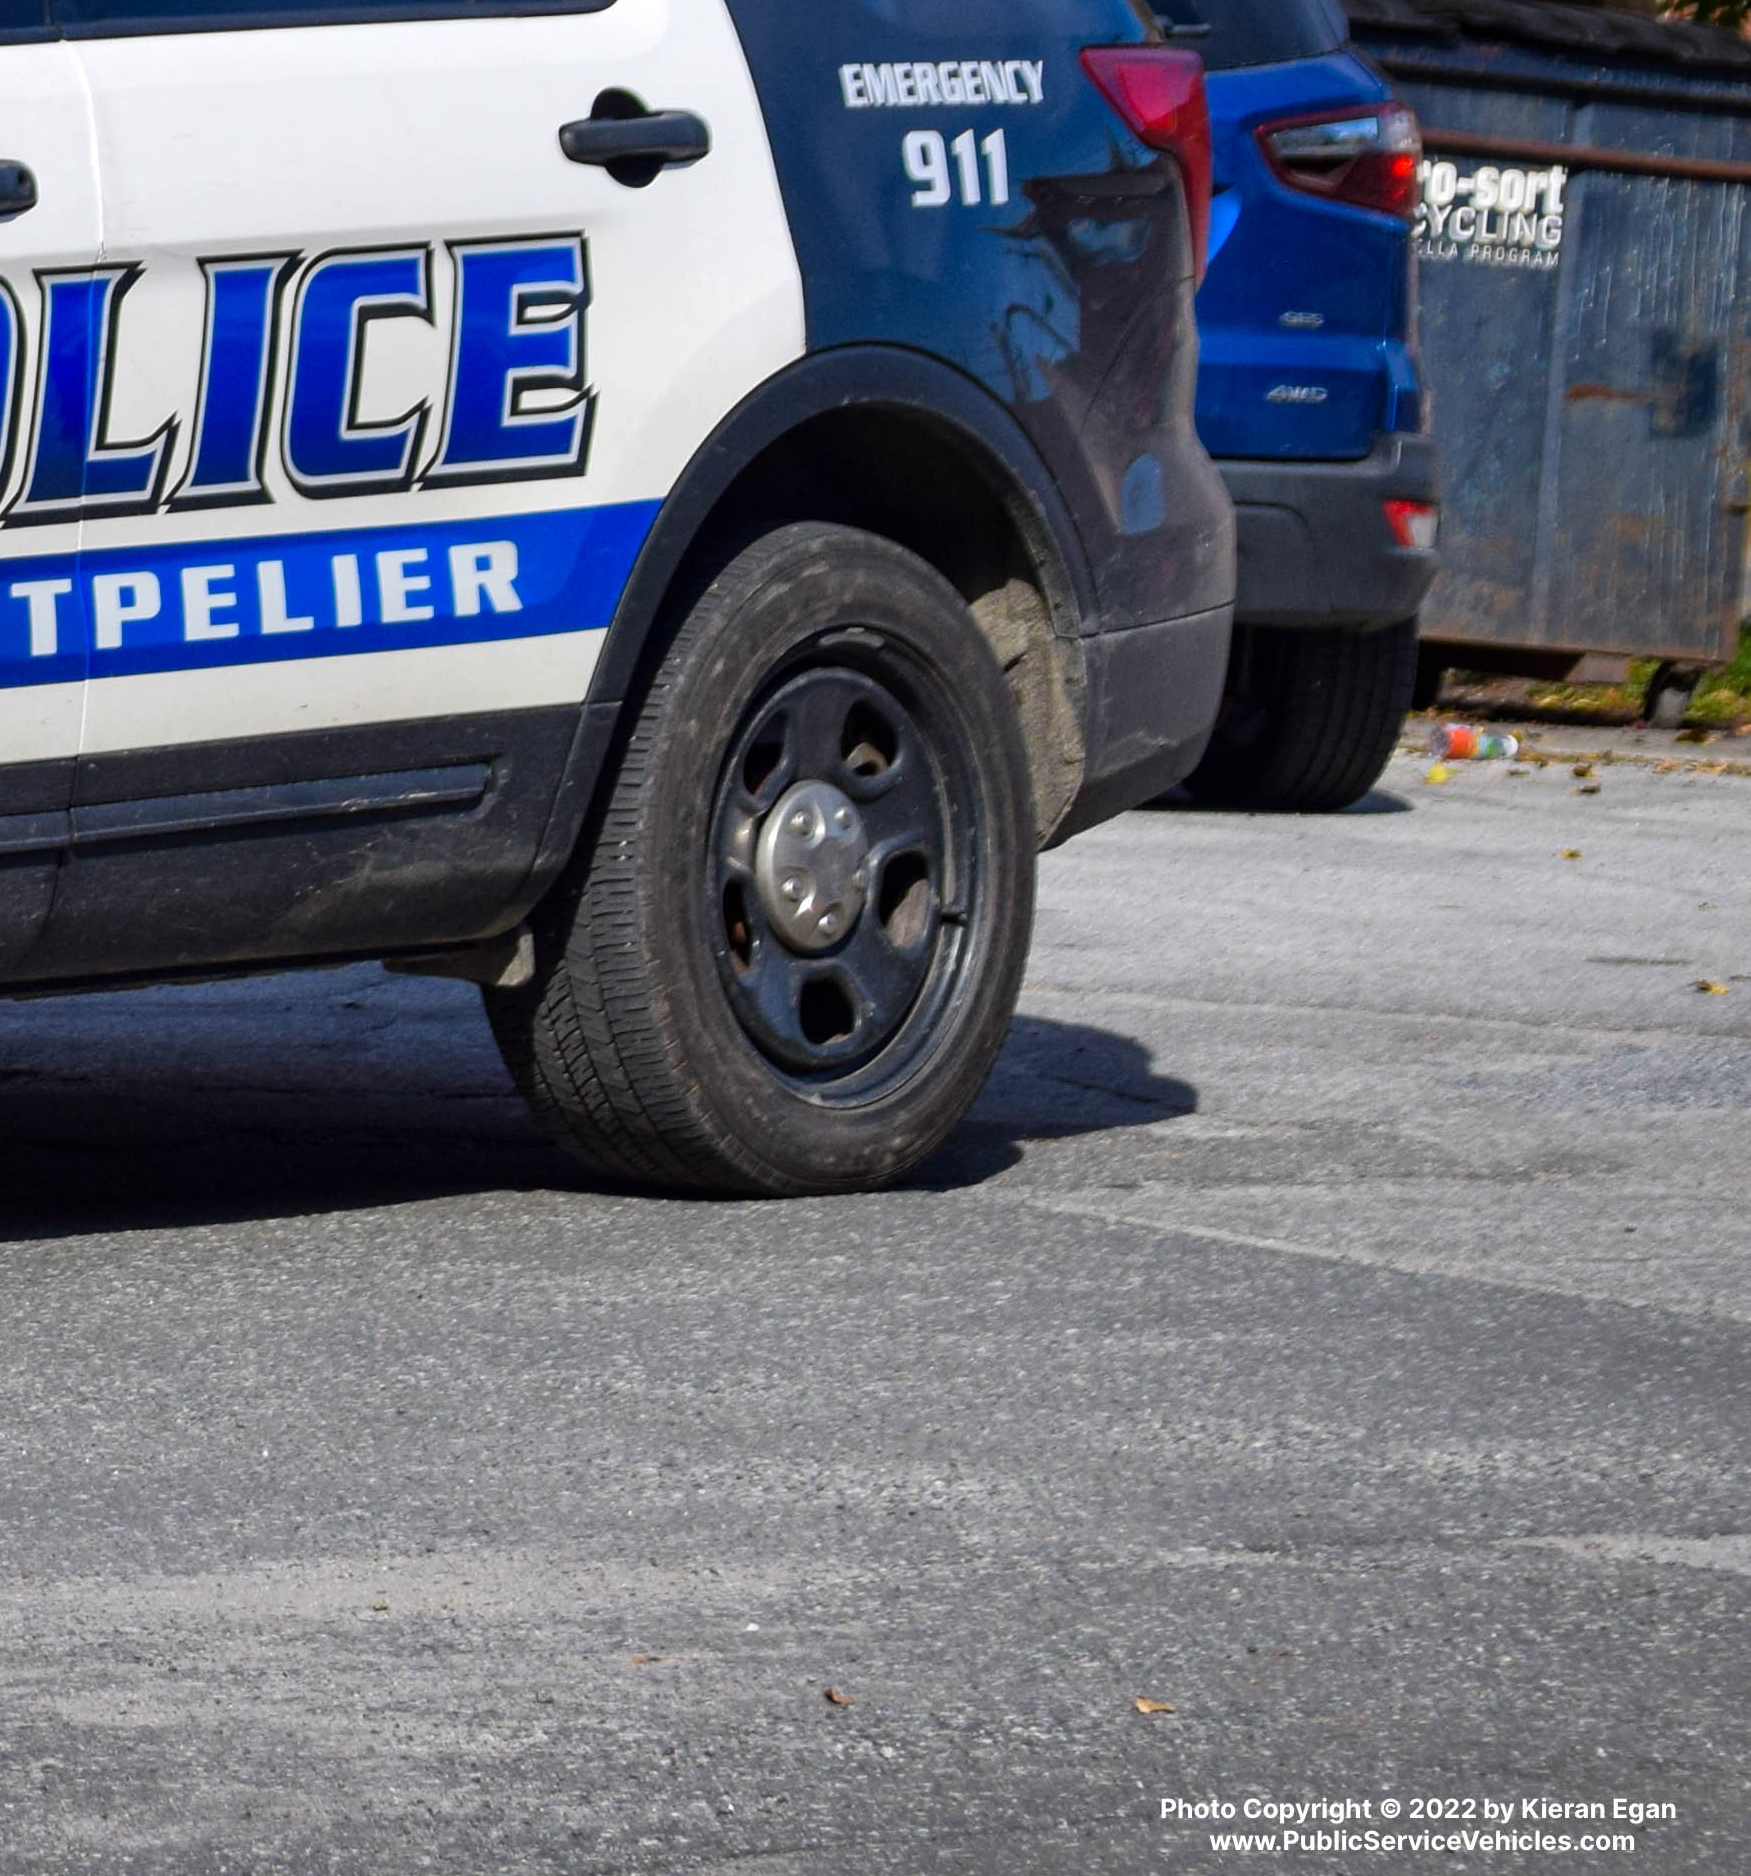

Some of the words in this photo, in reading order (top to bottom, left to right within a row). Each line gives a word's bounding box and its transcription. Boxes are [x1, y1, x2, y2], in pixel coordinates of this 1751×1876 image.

[838, 60, 1043, 108] EMERGENCY
[902, 128, 1009, 207] 911
[1417, 239, 1458, 258] LLA
[1470, 243, 1559, 267] PROGRAM
